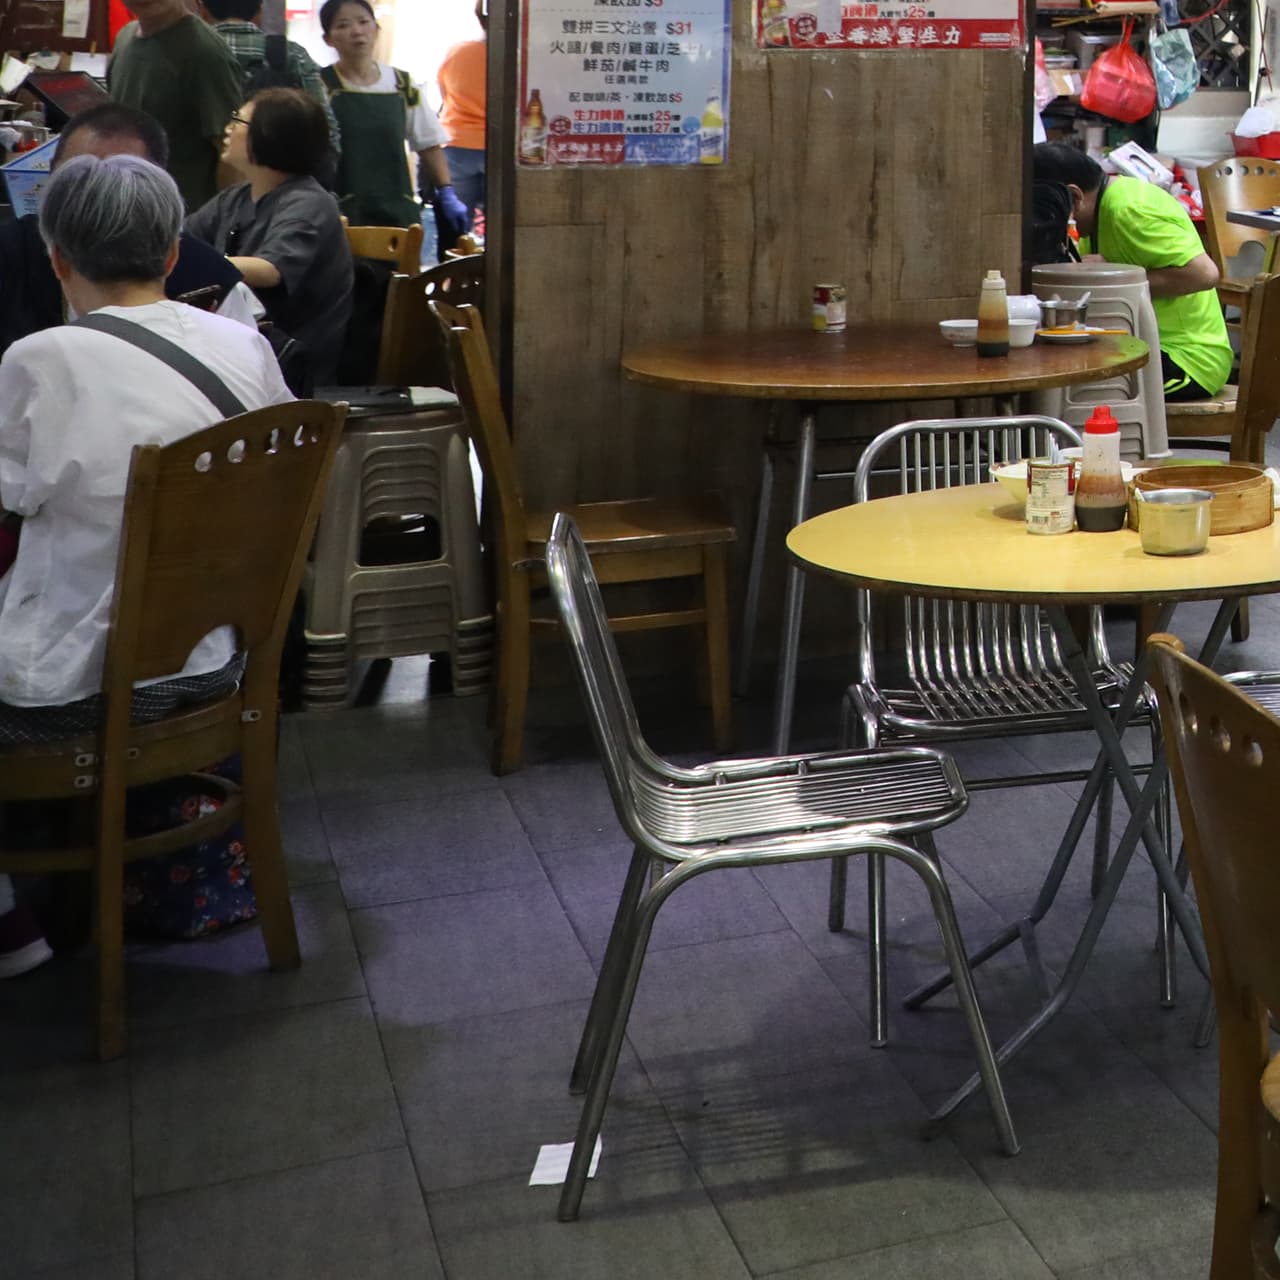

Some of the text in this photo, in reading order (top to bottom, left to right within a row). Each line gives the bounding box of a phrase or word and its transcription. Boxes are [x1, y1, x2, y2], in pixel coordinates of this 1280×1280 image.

[666, 22, 693, 35] $31
[897, 27, 962, 45] 堅生力
[574, 110, 624, 121] 生力啤酒
